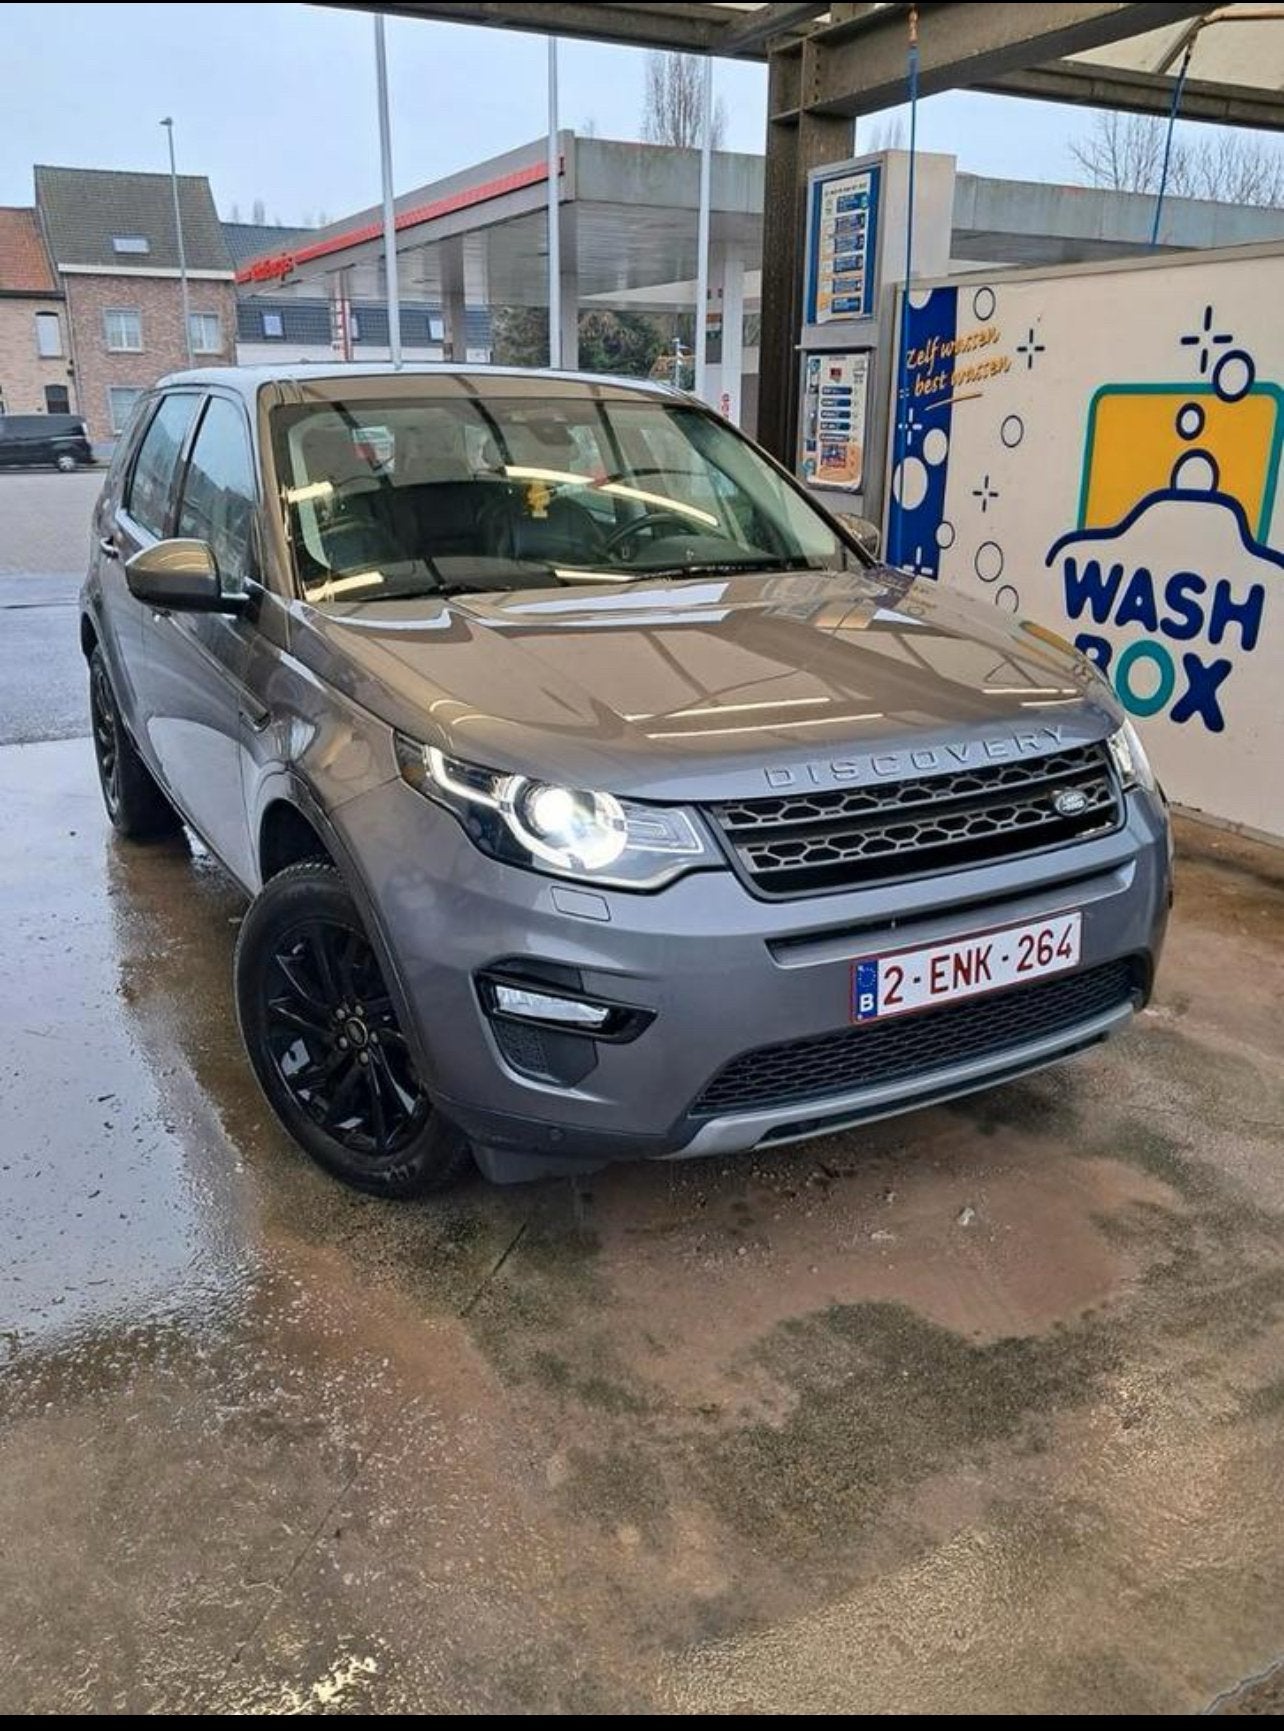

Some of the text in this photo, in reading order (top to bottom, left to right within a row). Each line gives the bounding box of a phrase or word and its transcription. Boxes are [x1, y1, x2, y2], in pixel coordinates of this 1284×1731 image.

[906, 335, 941, 376] Zelf
[914, 371, 948, 397] best
[1064, 557, 1265, 651] WASH
[763, 726, 1067, 789] DISCOVERY
[860, 994, 874, 1013] B
